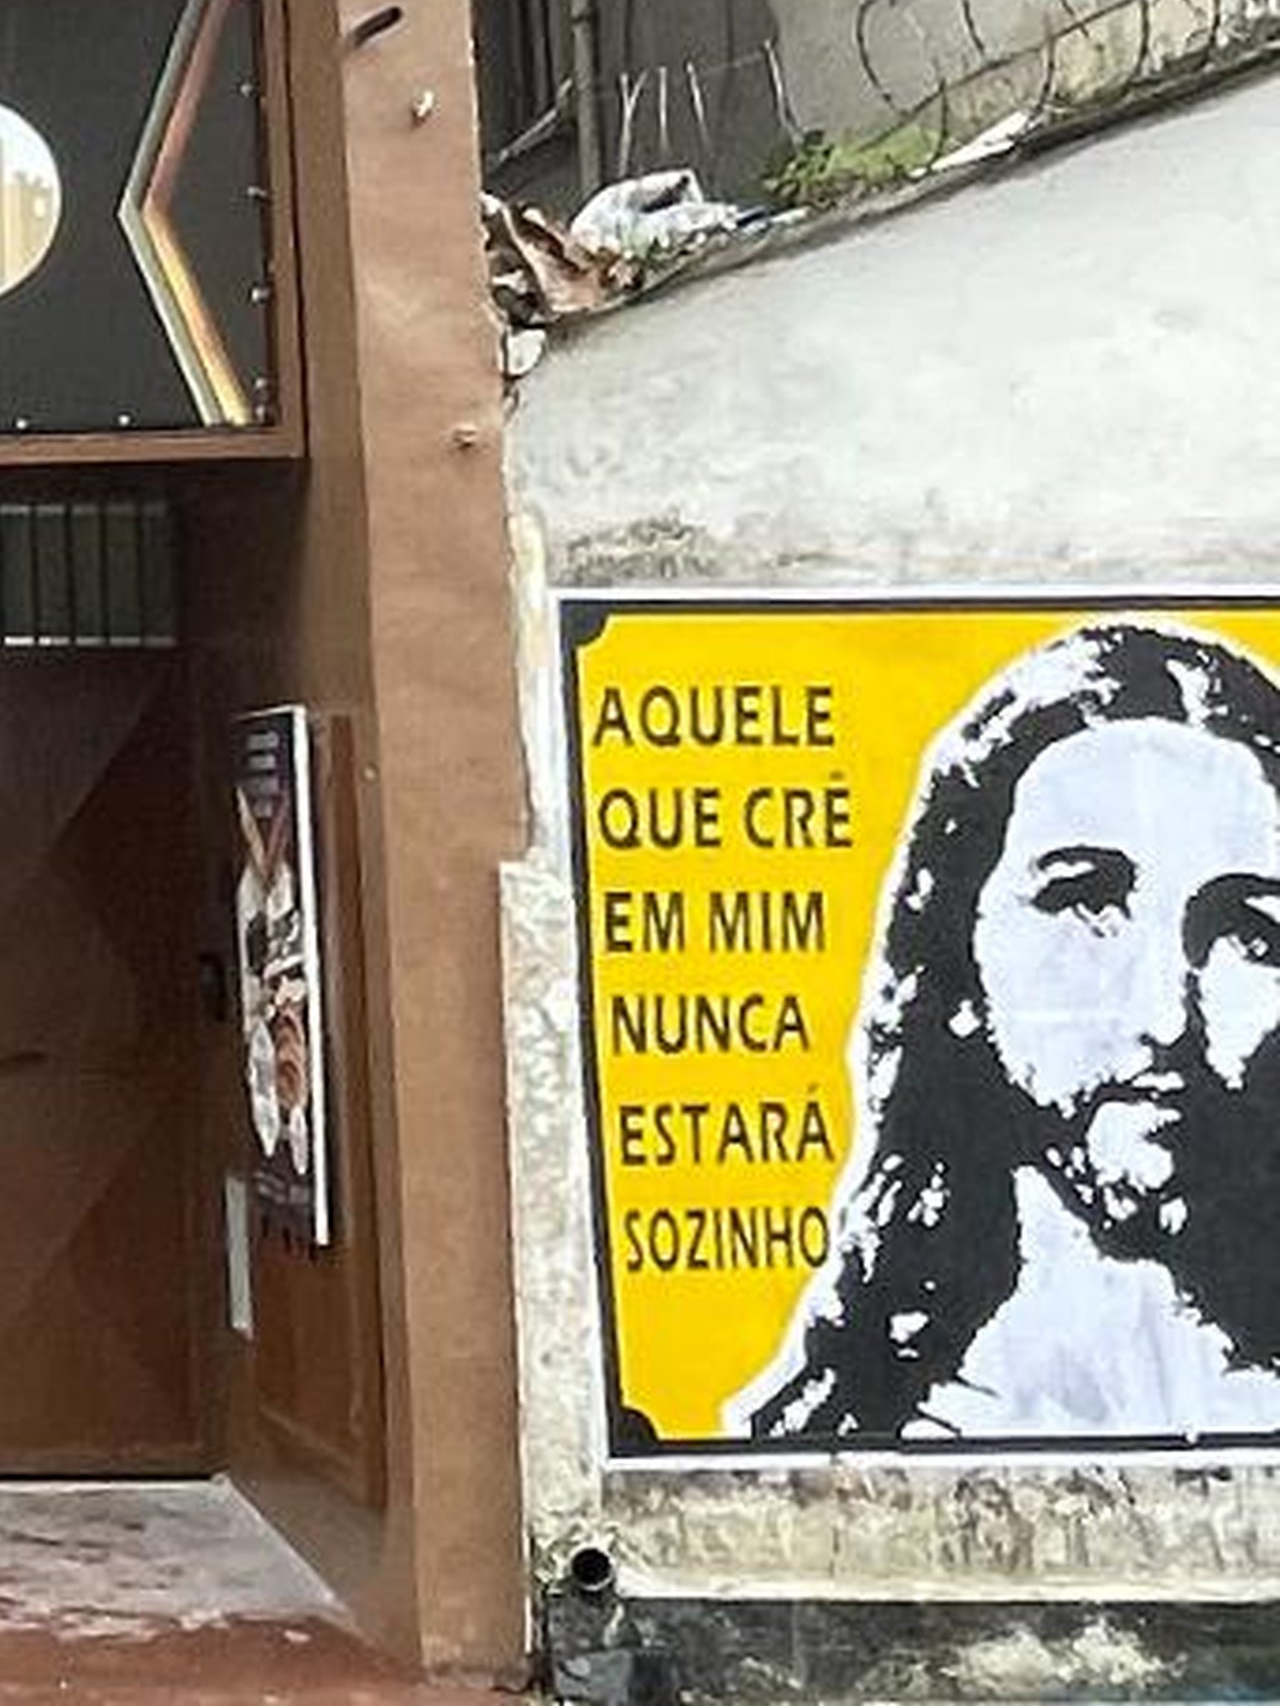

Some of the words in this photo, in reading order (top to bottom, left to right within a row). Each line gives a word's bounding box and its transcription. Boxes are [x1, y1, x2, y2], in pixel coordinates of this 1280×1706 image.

[592, 685, 835, 748] AQUELE
[598, 787, 723, 849] QUE
[603, 890, 686, 954] EM
[708, 890, 826, 954] MIM
[611, 993, 811, 1055] NUNCA
[619, 1082, 835, 1166] ESTARÁ
[624, 1206, 830, 1273] SOZINHO
